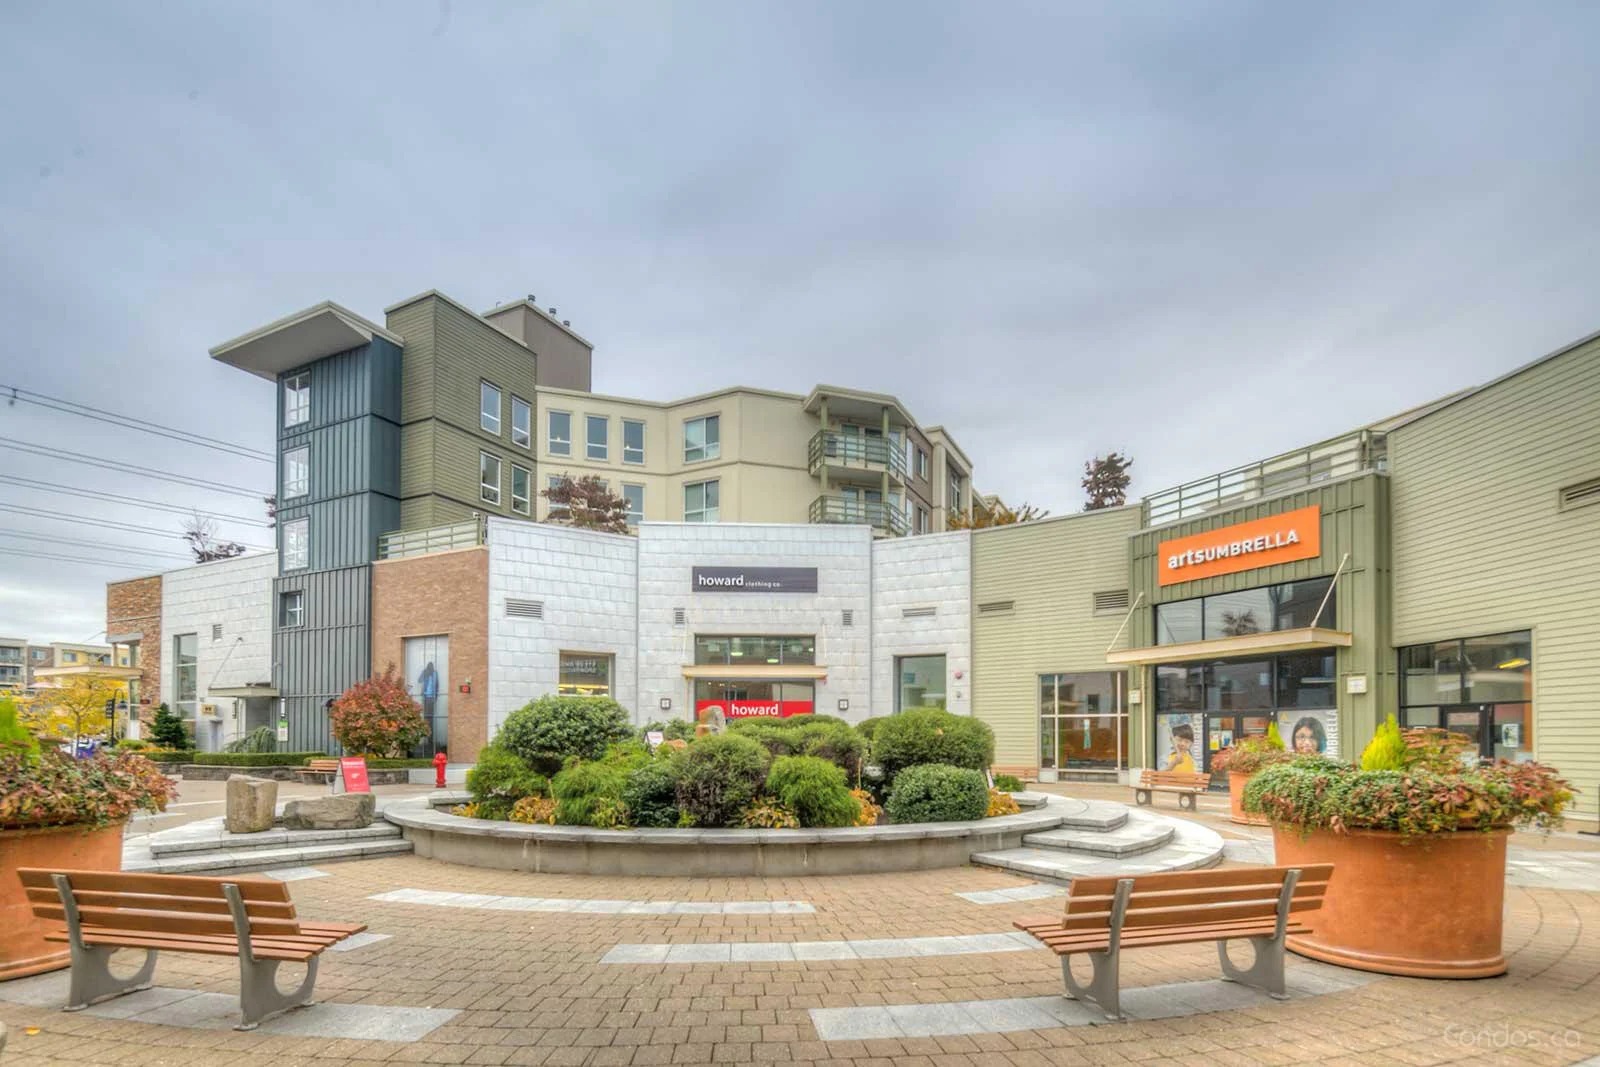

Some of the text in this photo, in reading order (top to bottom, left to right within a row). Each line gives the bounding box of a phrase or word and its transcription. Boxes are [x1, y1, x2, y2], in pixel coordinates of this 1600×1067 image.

[1168, 529, 1300, 569] artsUMBRELLA
[698, 574, 744, 586] howard
[731, 703, 779, 716] howard
